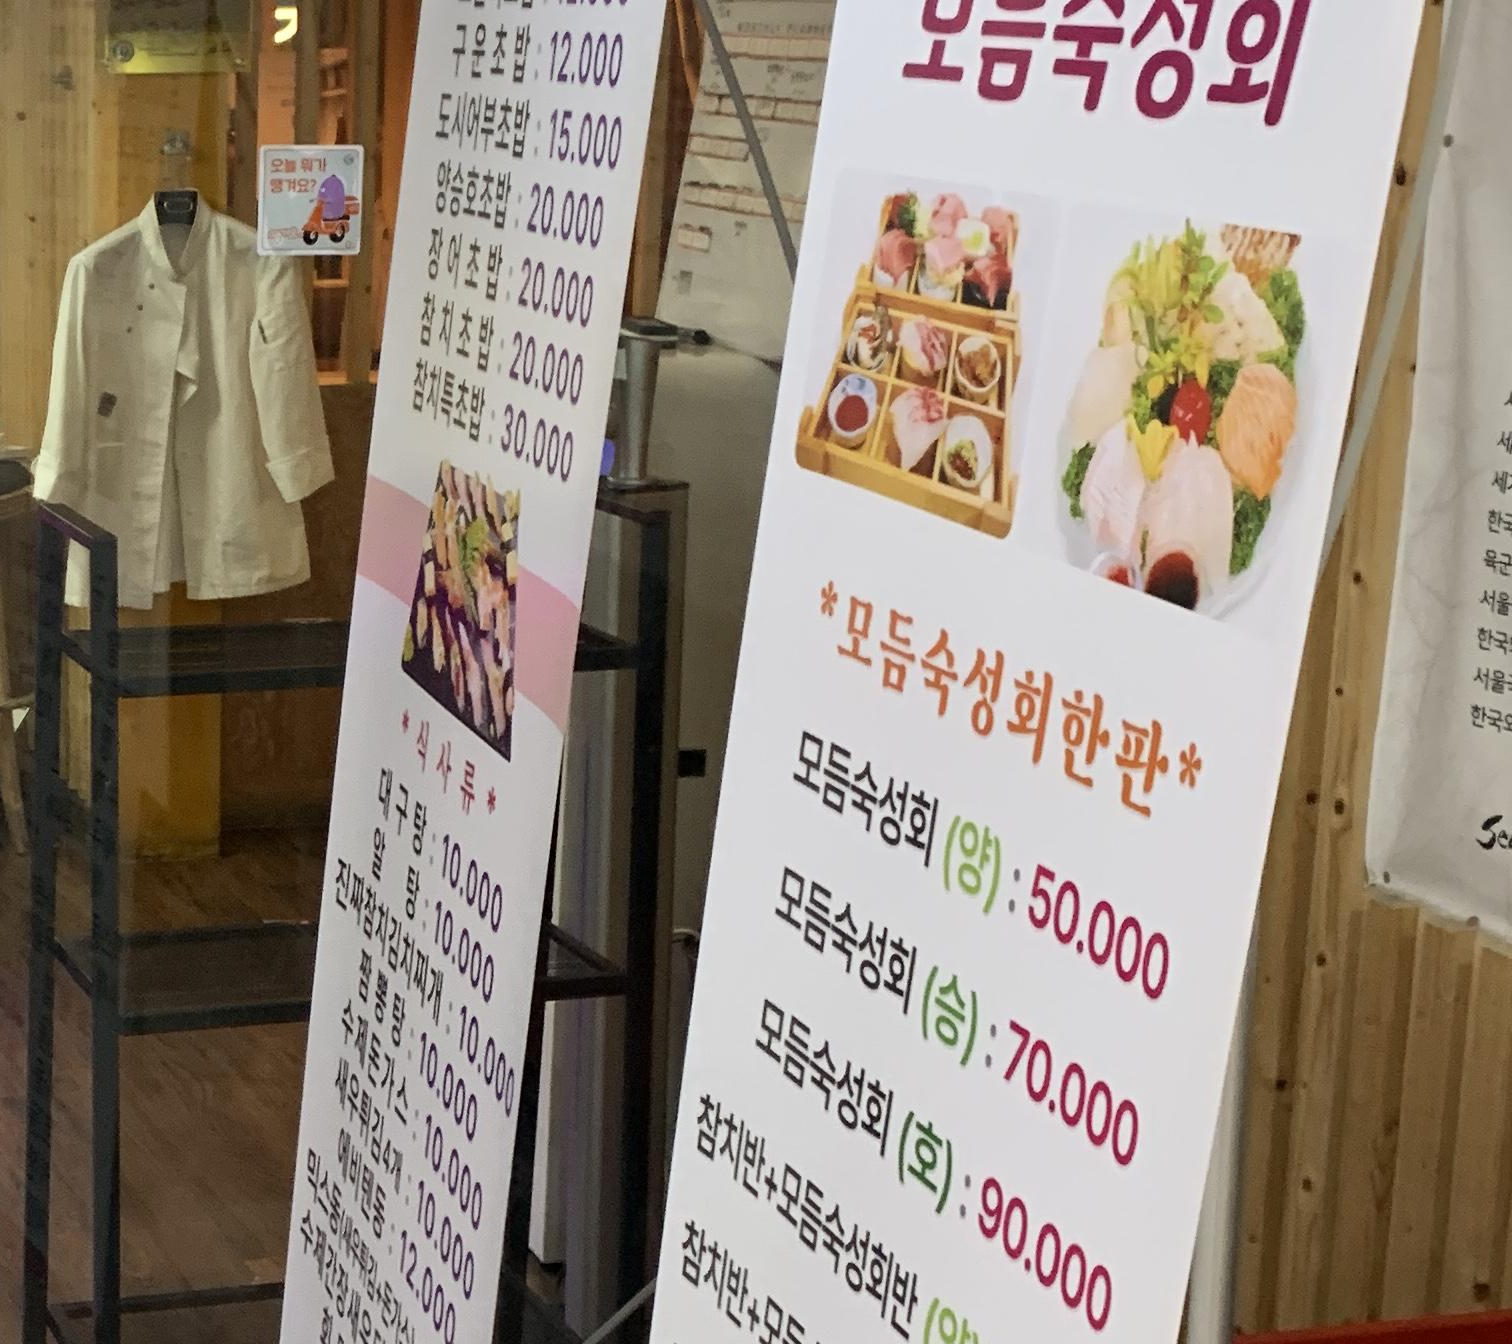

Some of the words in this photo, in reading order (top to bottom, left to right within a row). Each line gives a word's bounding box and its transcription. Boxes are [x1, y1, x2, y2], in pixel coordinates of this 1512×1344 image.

[549, 30, 623, 88] 12.000
[434, 91, 530, 159] 도시어부초밥
[548, 108, 622, 170] 15.000
[434, 158, 511, 229] 양승호초밥
[525, 181, 604, 249] 20.000
[517, 256, 594, 328] 20.000
[508, 330, 583, 406] 20.000
[499, 402, 574, 482] 30.000
[441, 833, 503, 933] 10.000
[1027, 863, 1169, 1000] 50.000
[433, 900, 495, 1003] 10.000
[418, 1031, 478, 1142] 10.000
[458, 1004, 515, 1117] 10.000
[1003, 1019, 1139, 1166] 70.000
[423, 1113, 483, 1231] 10.000
[416, 1179, 475, 1300] 10.000
[977, 1176, 1112, 1331] 90.000
